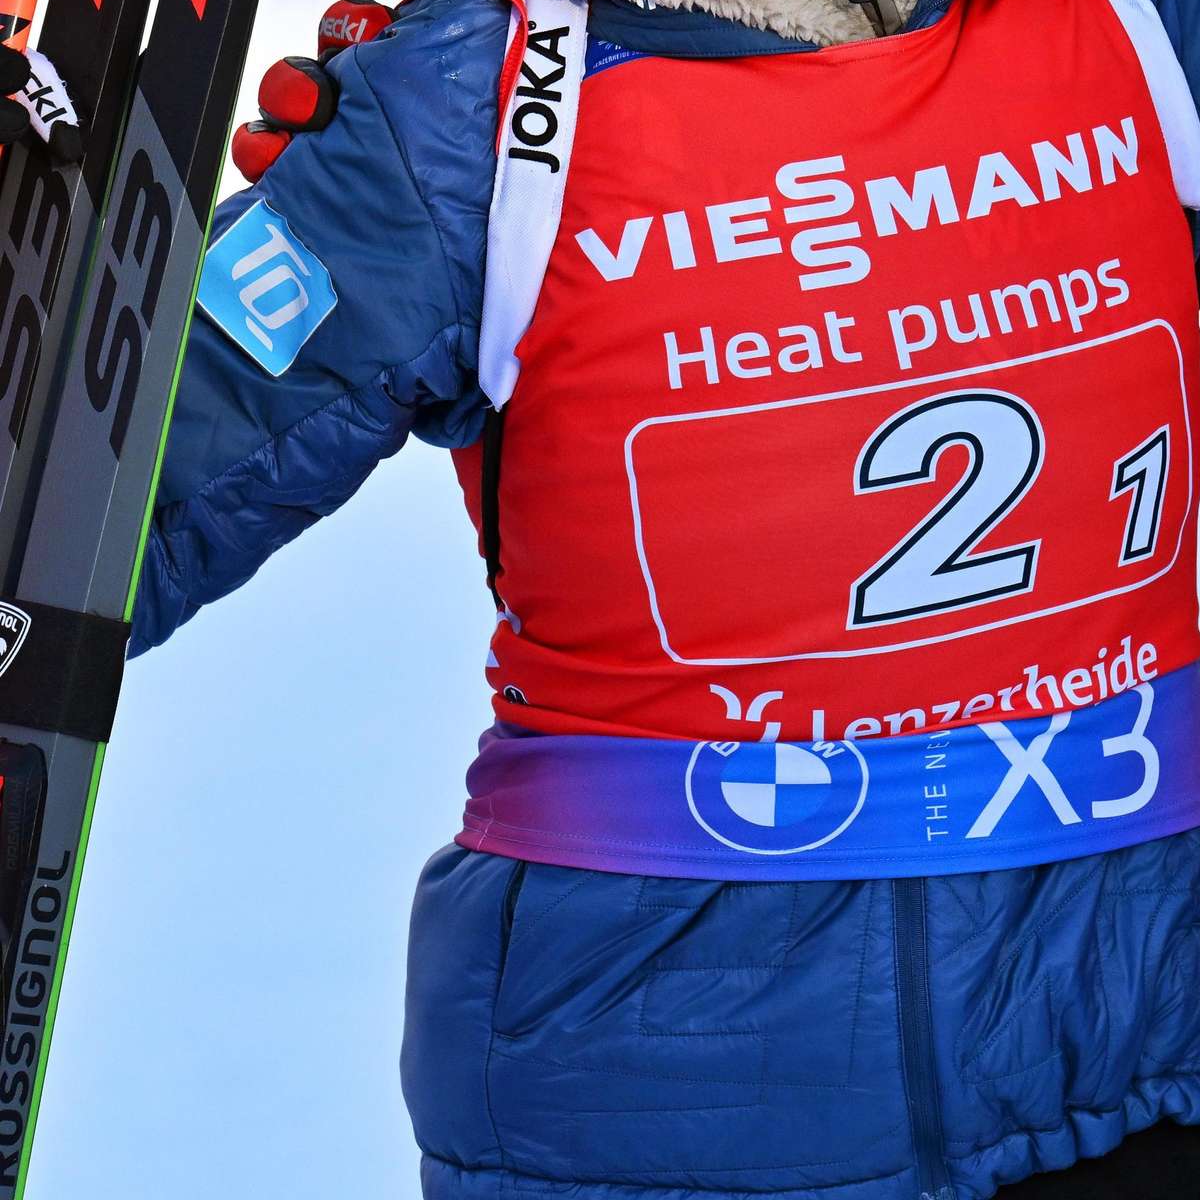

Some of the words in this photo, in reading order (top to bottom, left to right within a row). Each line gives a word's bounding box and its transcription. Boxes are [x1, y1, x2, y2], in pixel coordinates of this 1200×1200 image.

[575, 117, 1139, 290] VIESSMANN
[664, 310, 863, 390] Heat
[890, 258, 1131, 369] pumps
[846, 388, 1046, 631] 2
[1109, 425, 1171, 567] 1
[965, 682, 1161, 839] X3
